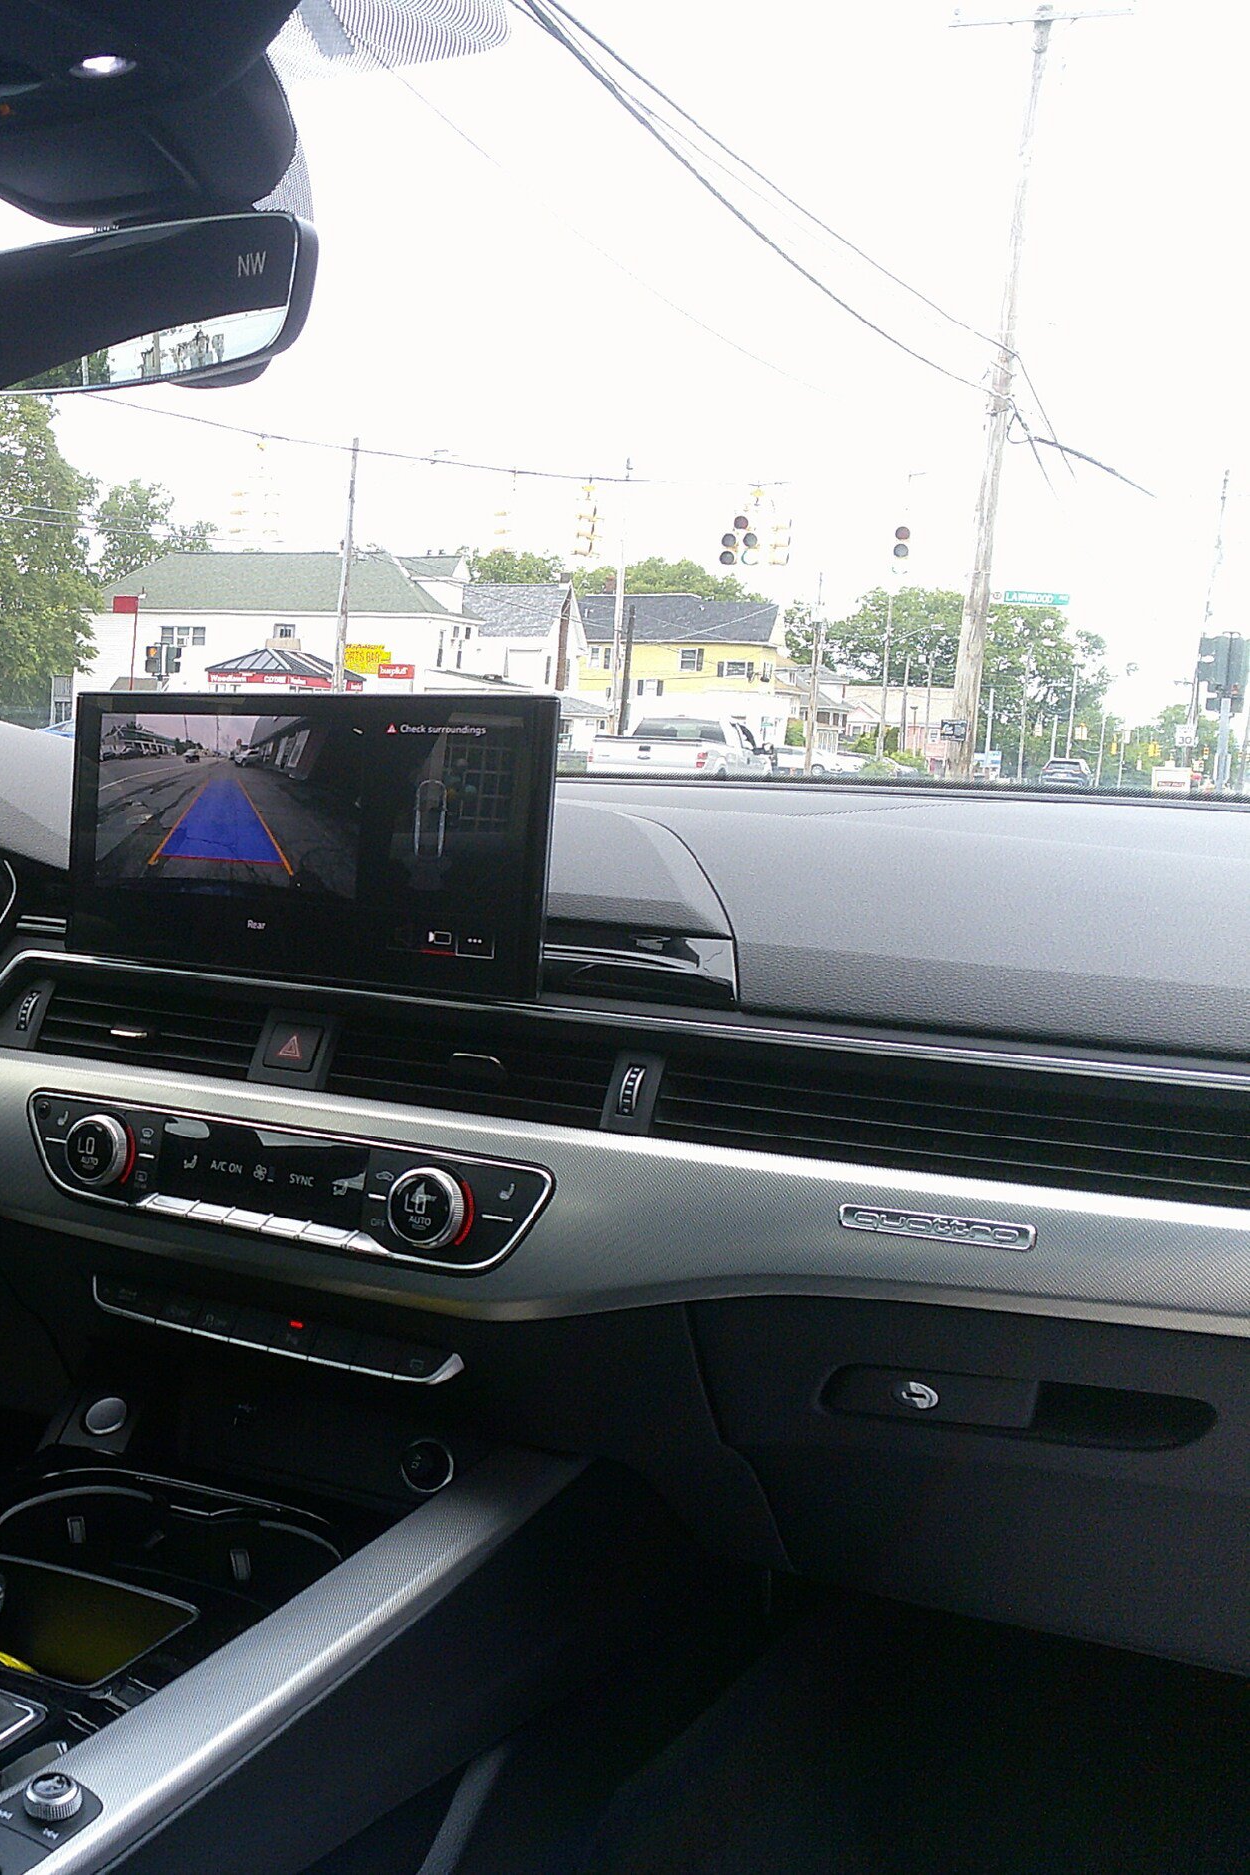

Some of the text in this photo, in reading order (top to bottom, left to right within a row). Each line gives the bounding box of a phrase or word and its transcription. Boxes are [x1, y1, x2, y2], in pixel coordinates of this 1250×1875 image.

[237, 251, 266, 278] NW
[400, 723, 487, 737] Check surroundings
[1178, 736, 1193, 745] 30
[247, 918, 266, 931] Rear
[77, 1136, 95, 1155] LO
[81, 1156, 99, 1166] AUTO
[210, 1160, 243, 1175] A/C ON
[288, 1173, 315, 1187] SYNC
[408, 1215, 432, 1226] AUTO
[854, 1210, 1020, 1243] quattro
